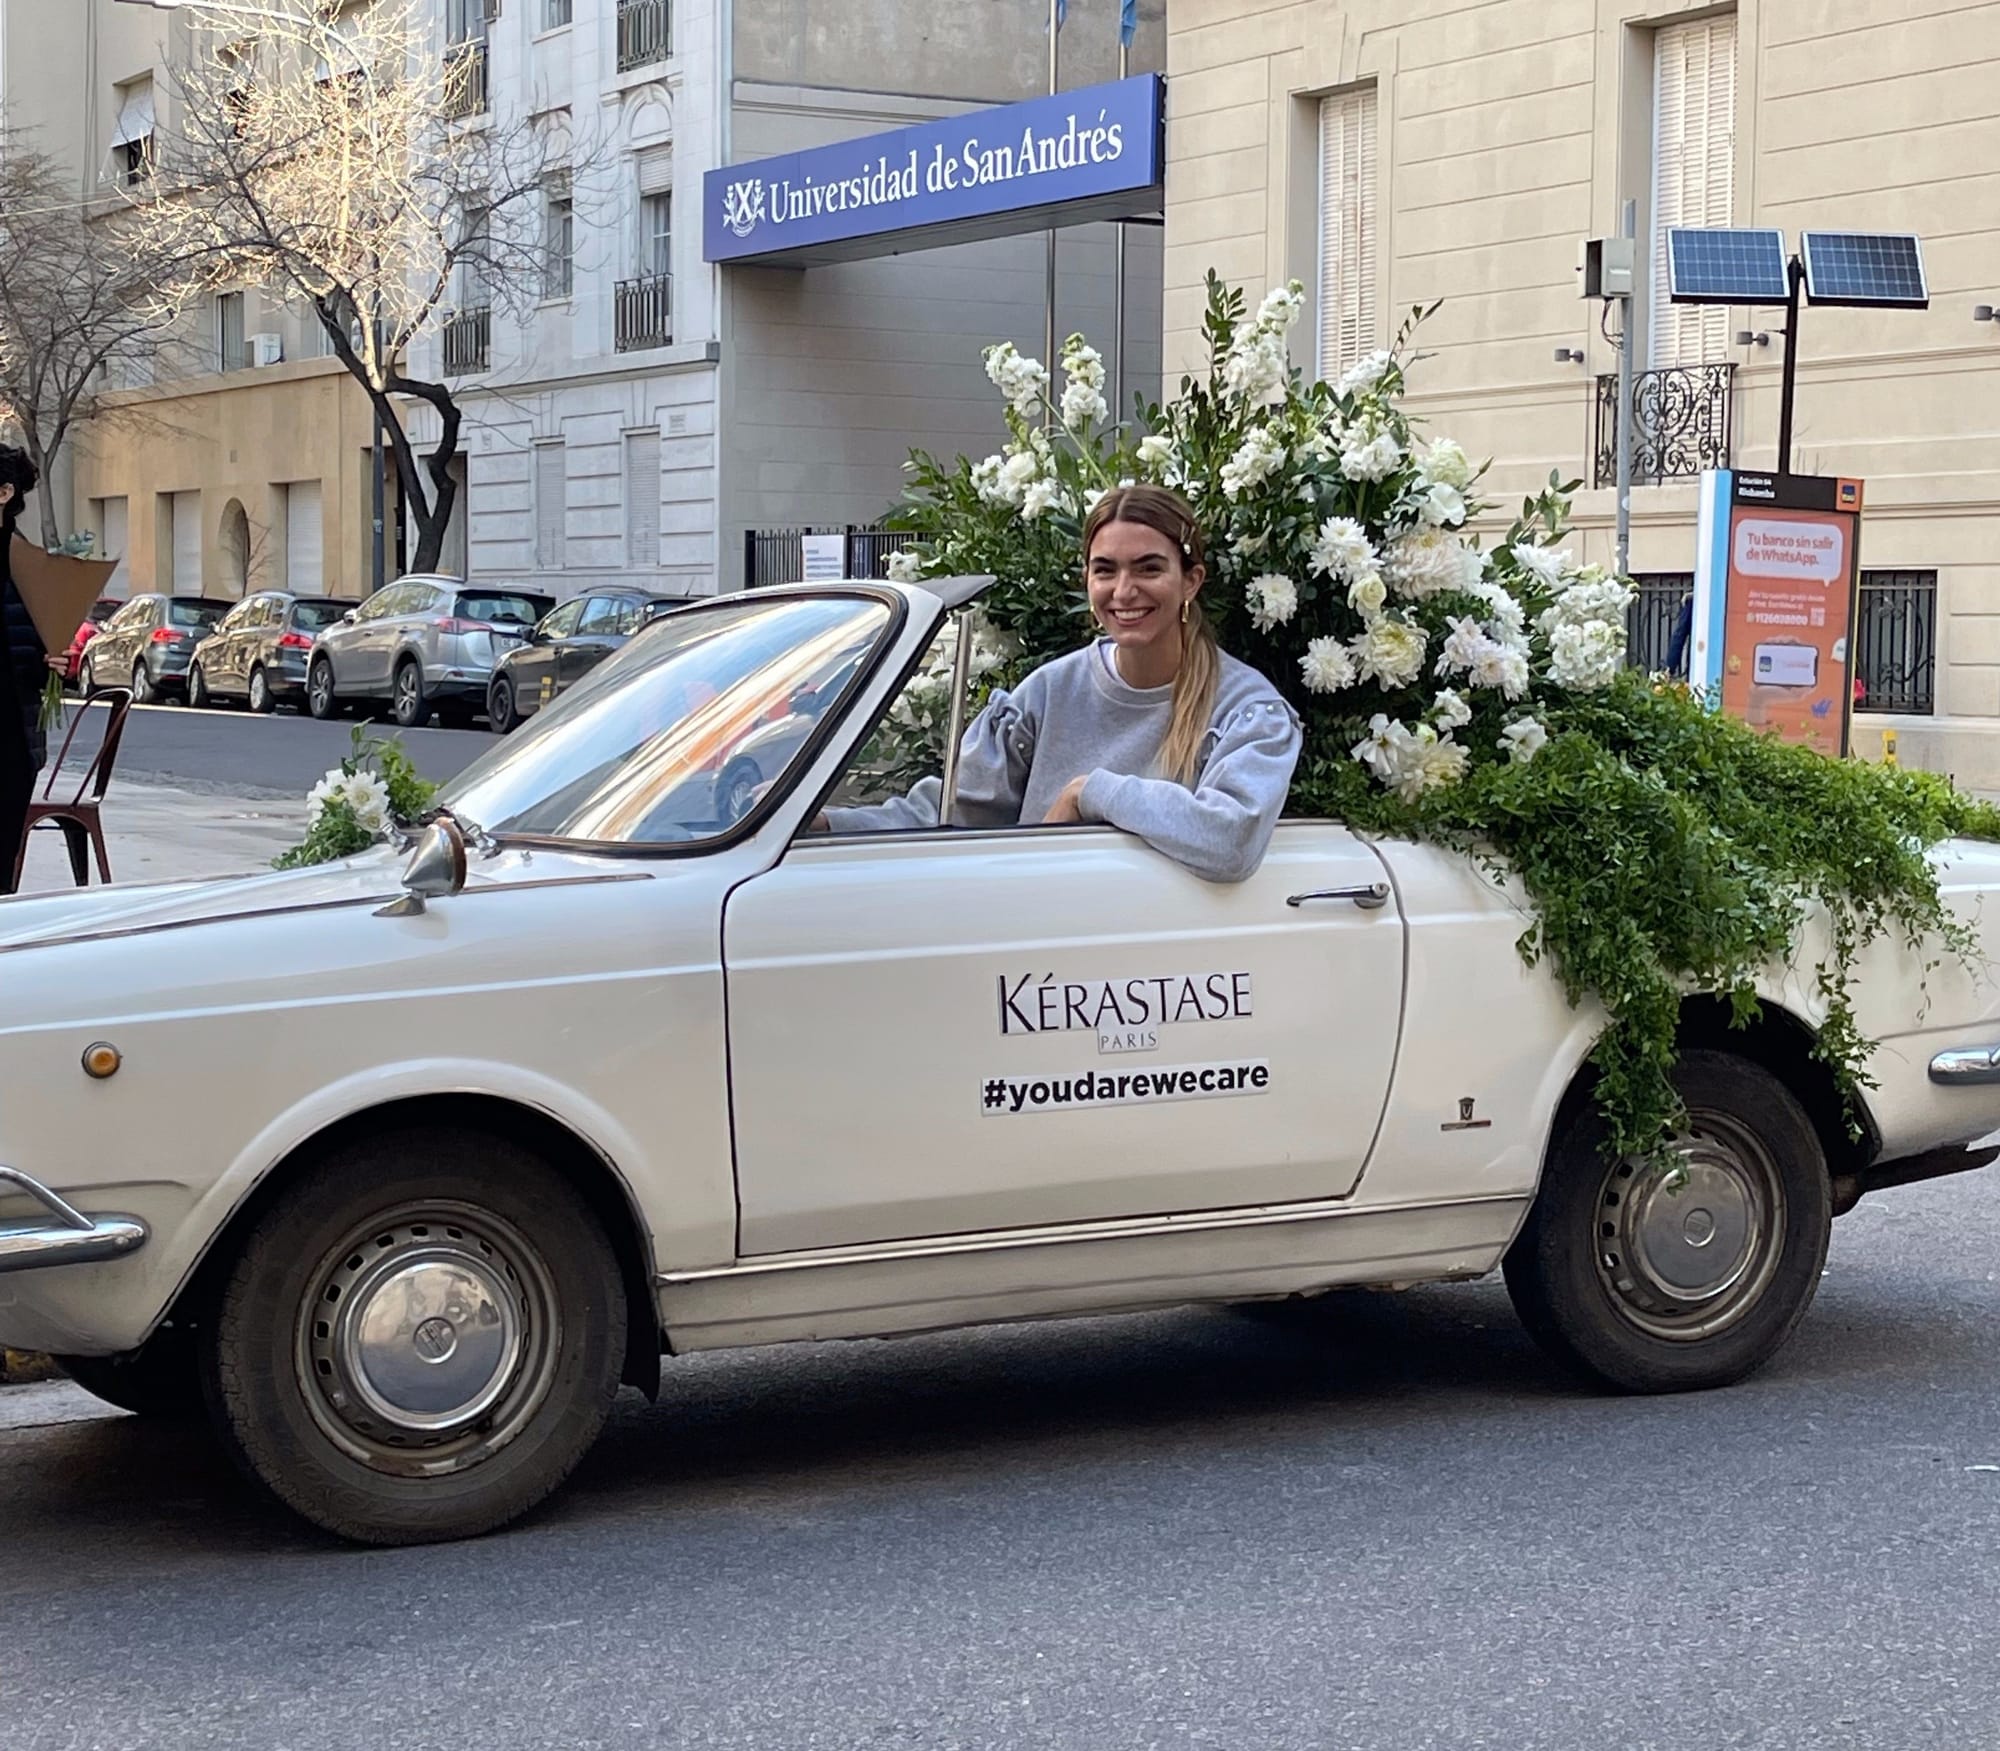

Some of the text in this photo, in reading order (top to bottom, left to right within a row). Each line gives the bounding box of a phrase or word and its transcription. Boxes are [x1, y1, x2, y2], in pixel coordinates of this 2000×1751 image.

[769, 108, 1123, 223] Universidad de San Andrés
[1746, 548, 1819, 566] de WhatsApp.
[1747, 532, 1833, 549] Tu banco sin salir
[999, 972, 1253, 1034] KÉRASTASE
[1101, 1031, 1157, 1049] PARIS
[983, 1064, 1269, 1112] #youdarewecare
